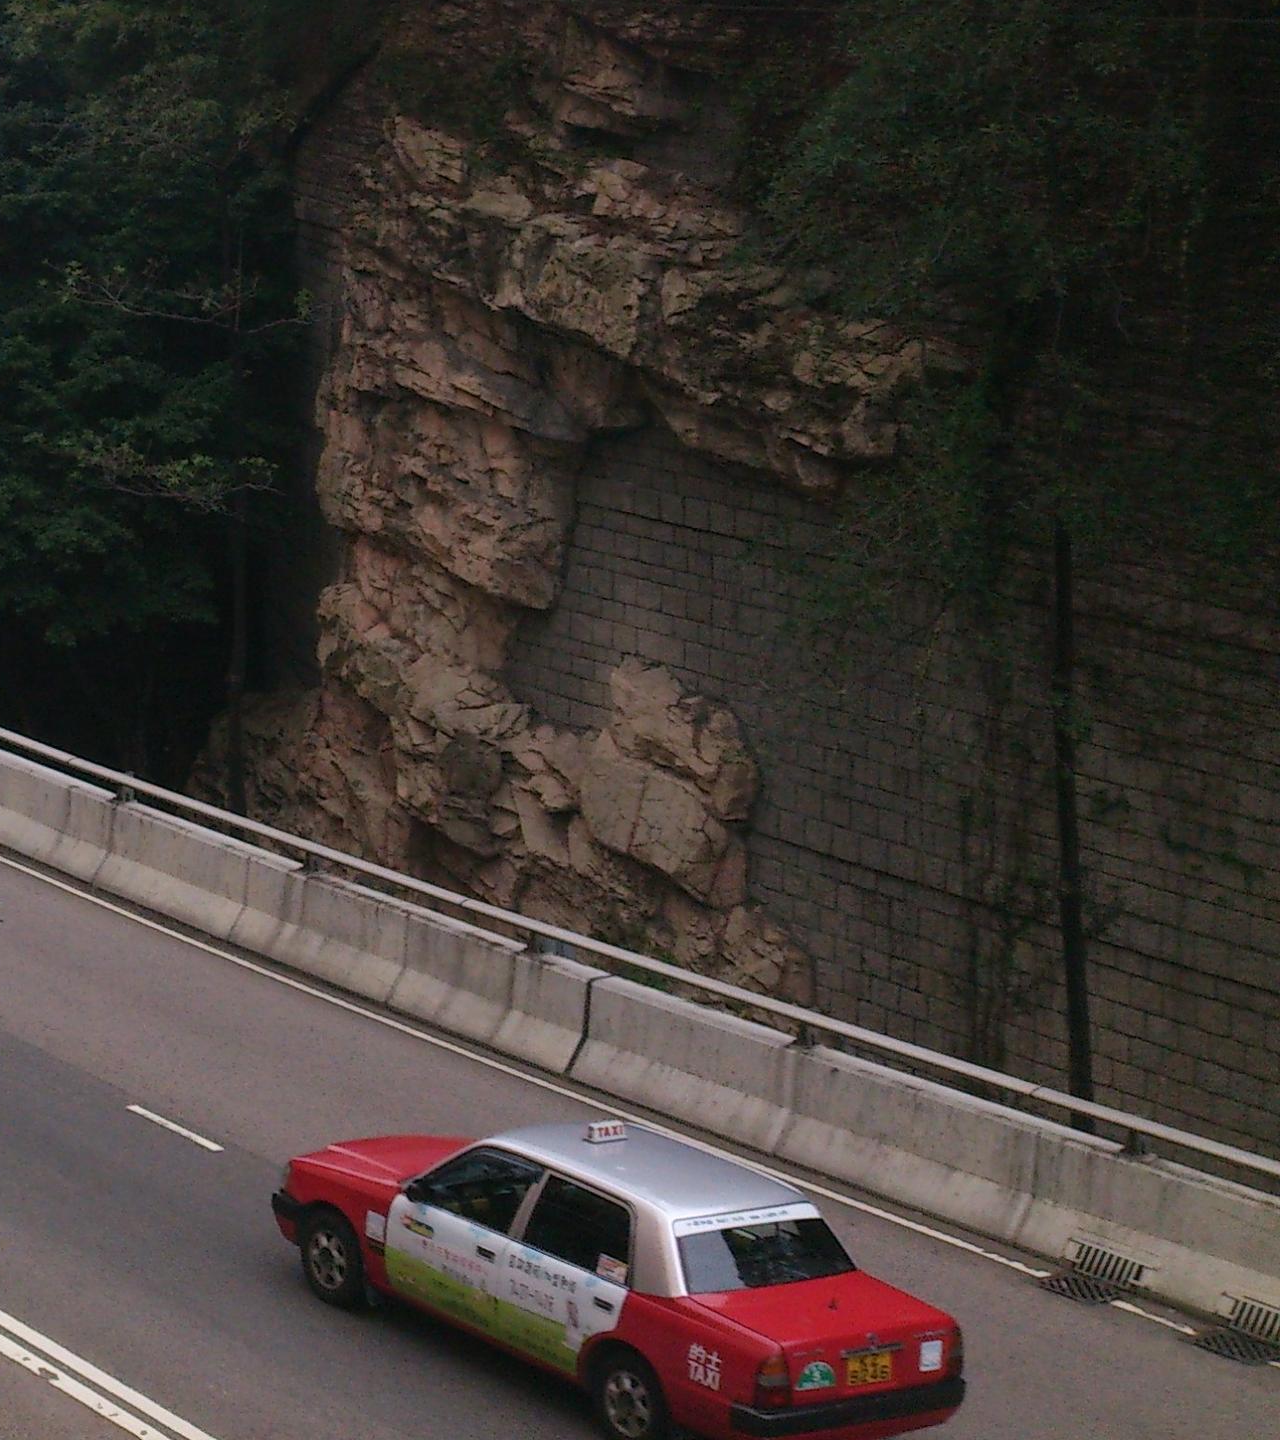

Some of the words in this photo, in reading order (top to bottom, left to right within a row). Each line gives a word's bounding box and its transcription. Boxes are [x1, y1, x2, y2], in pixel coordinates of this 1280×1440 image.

[597, 1125, 624, 1138] TAXI
[688, 1343, 722, 1372] 的士
[688, 1359, 721, 1391] TAXI
